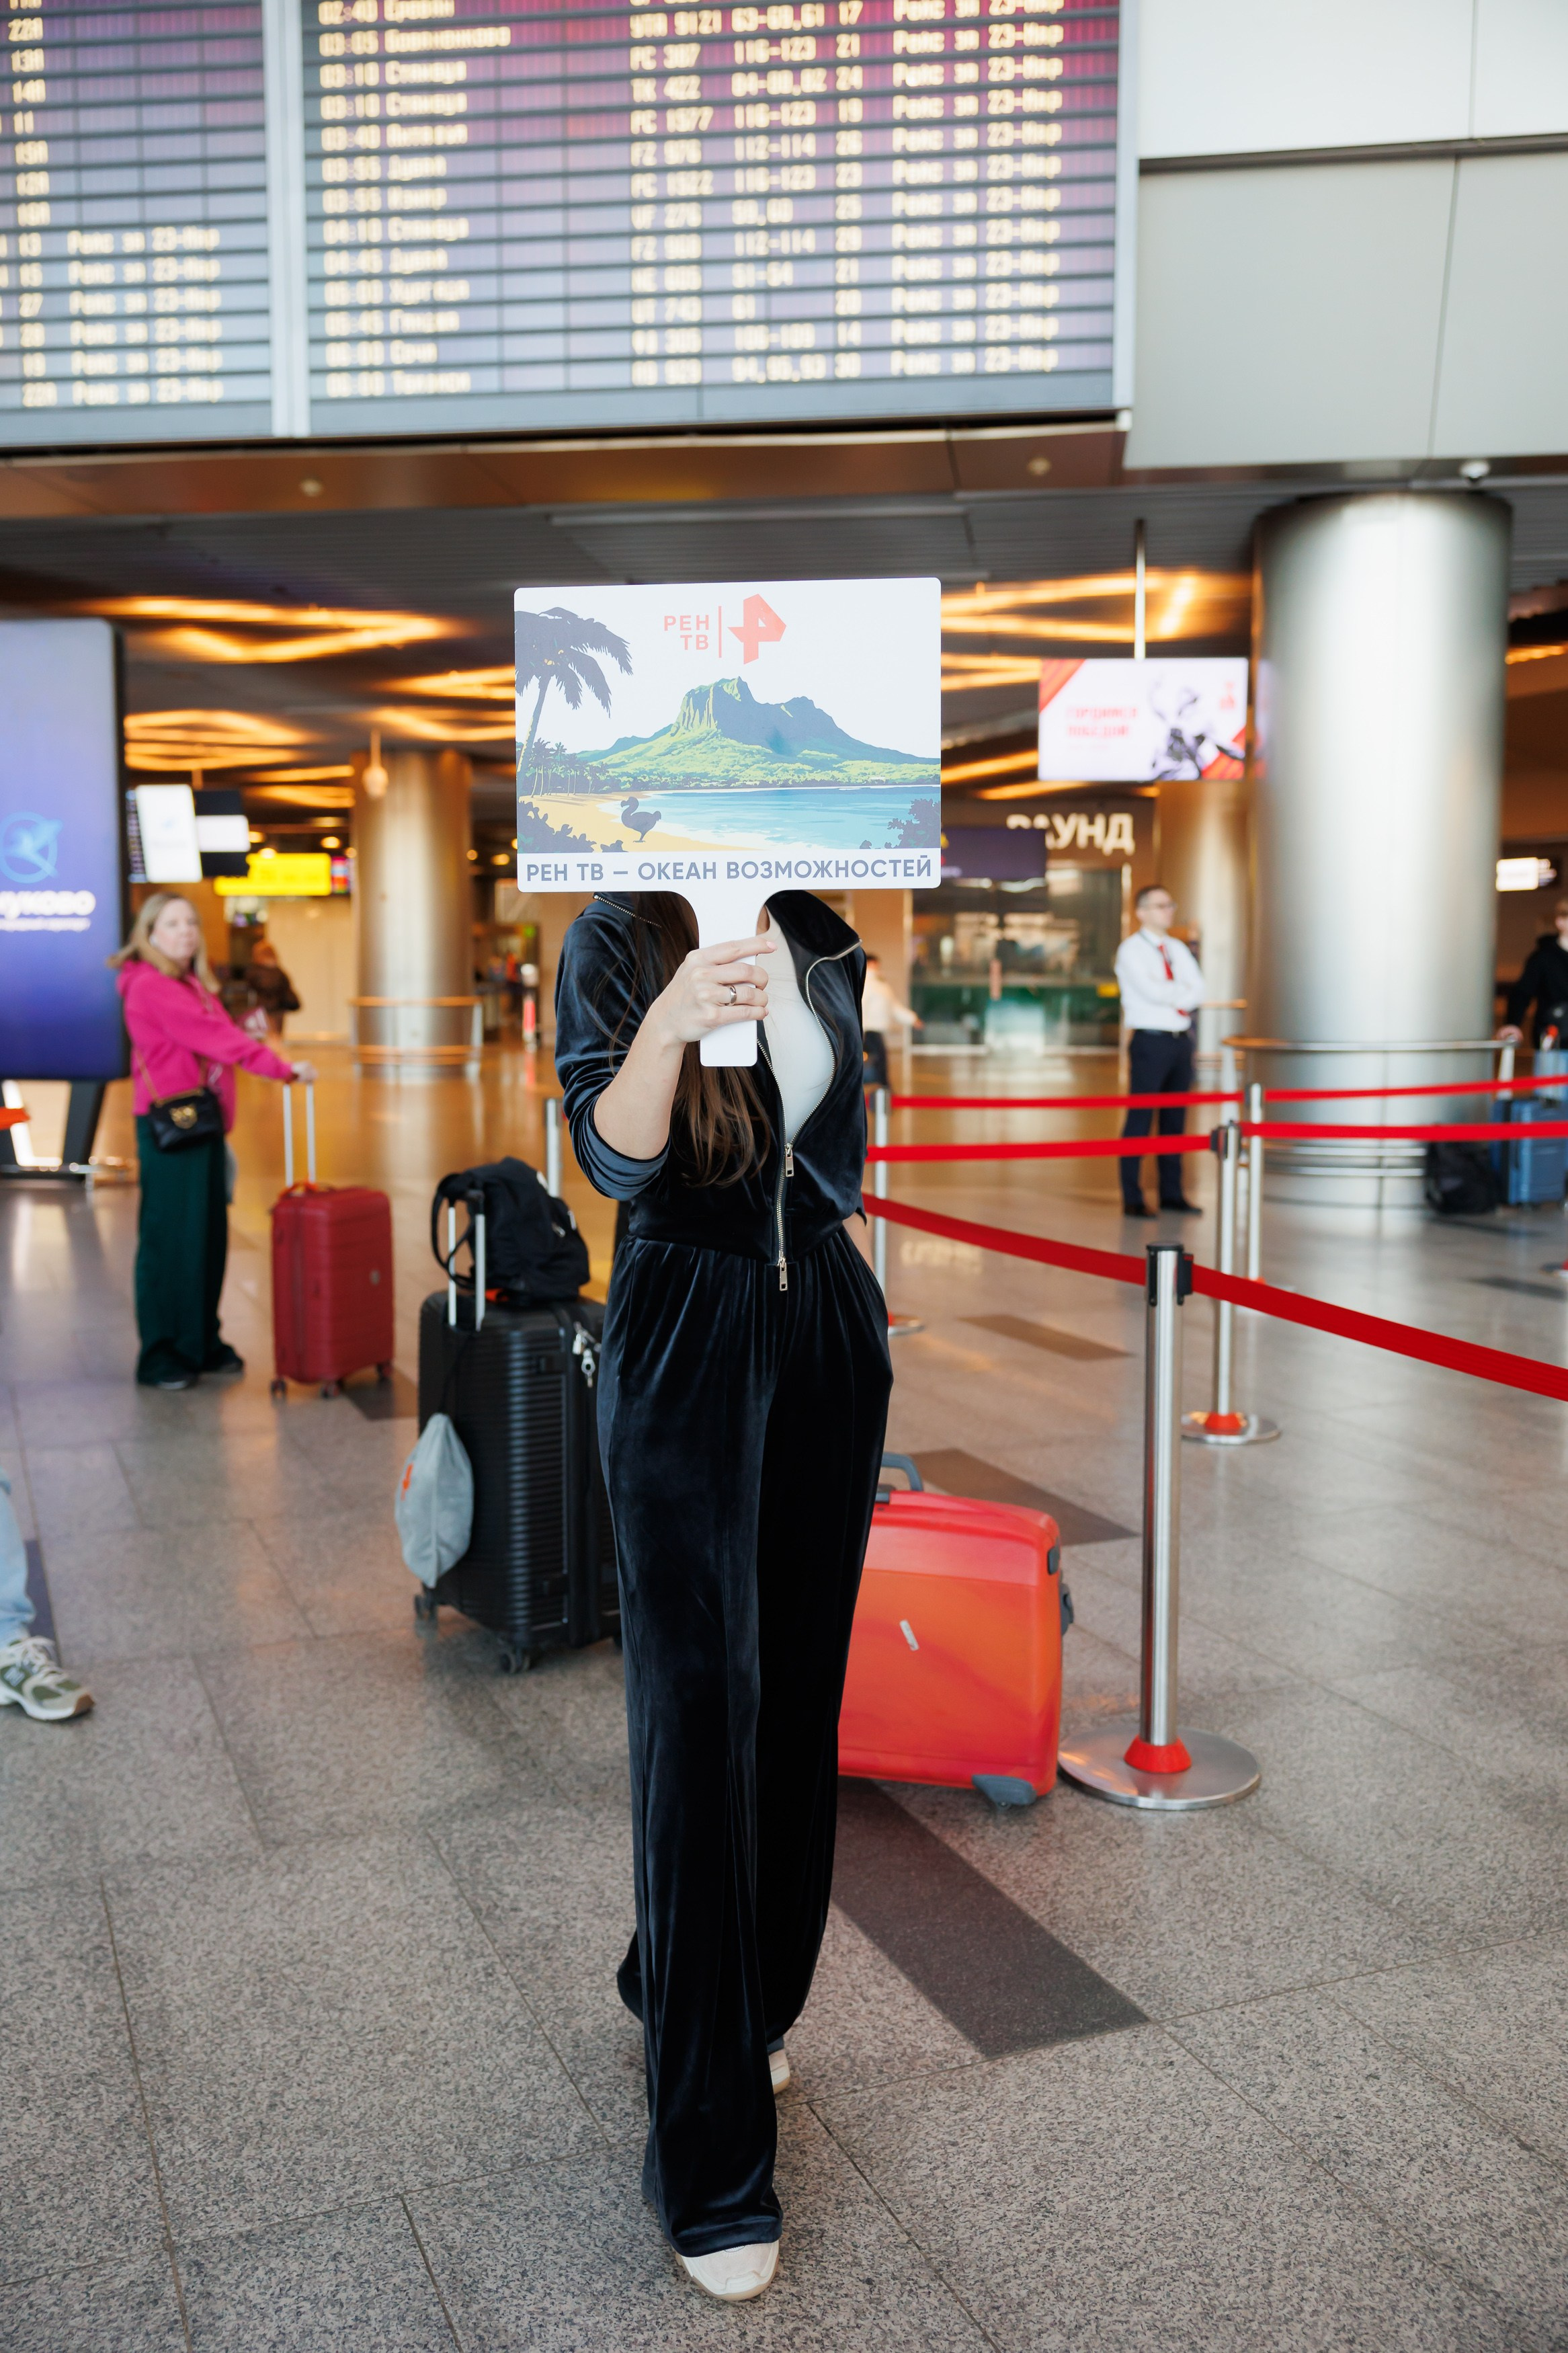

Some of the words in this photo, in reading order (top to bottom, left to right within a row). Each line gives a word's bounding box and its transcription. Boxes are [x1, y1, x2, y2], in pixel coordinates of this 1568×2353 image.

[665, 615, 708, 631] РЕН
[680, 635, 708, 650] ТВ
[528, 864, 567, 881] РЕН
[577, 864, 603, 881] ТВ
[638, 862, 716, 880] ОКЕАН
[727, 855, 930, 879] ВОЗМОЖНОСТЕЙ
